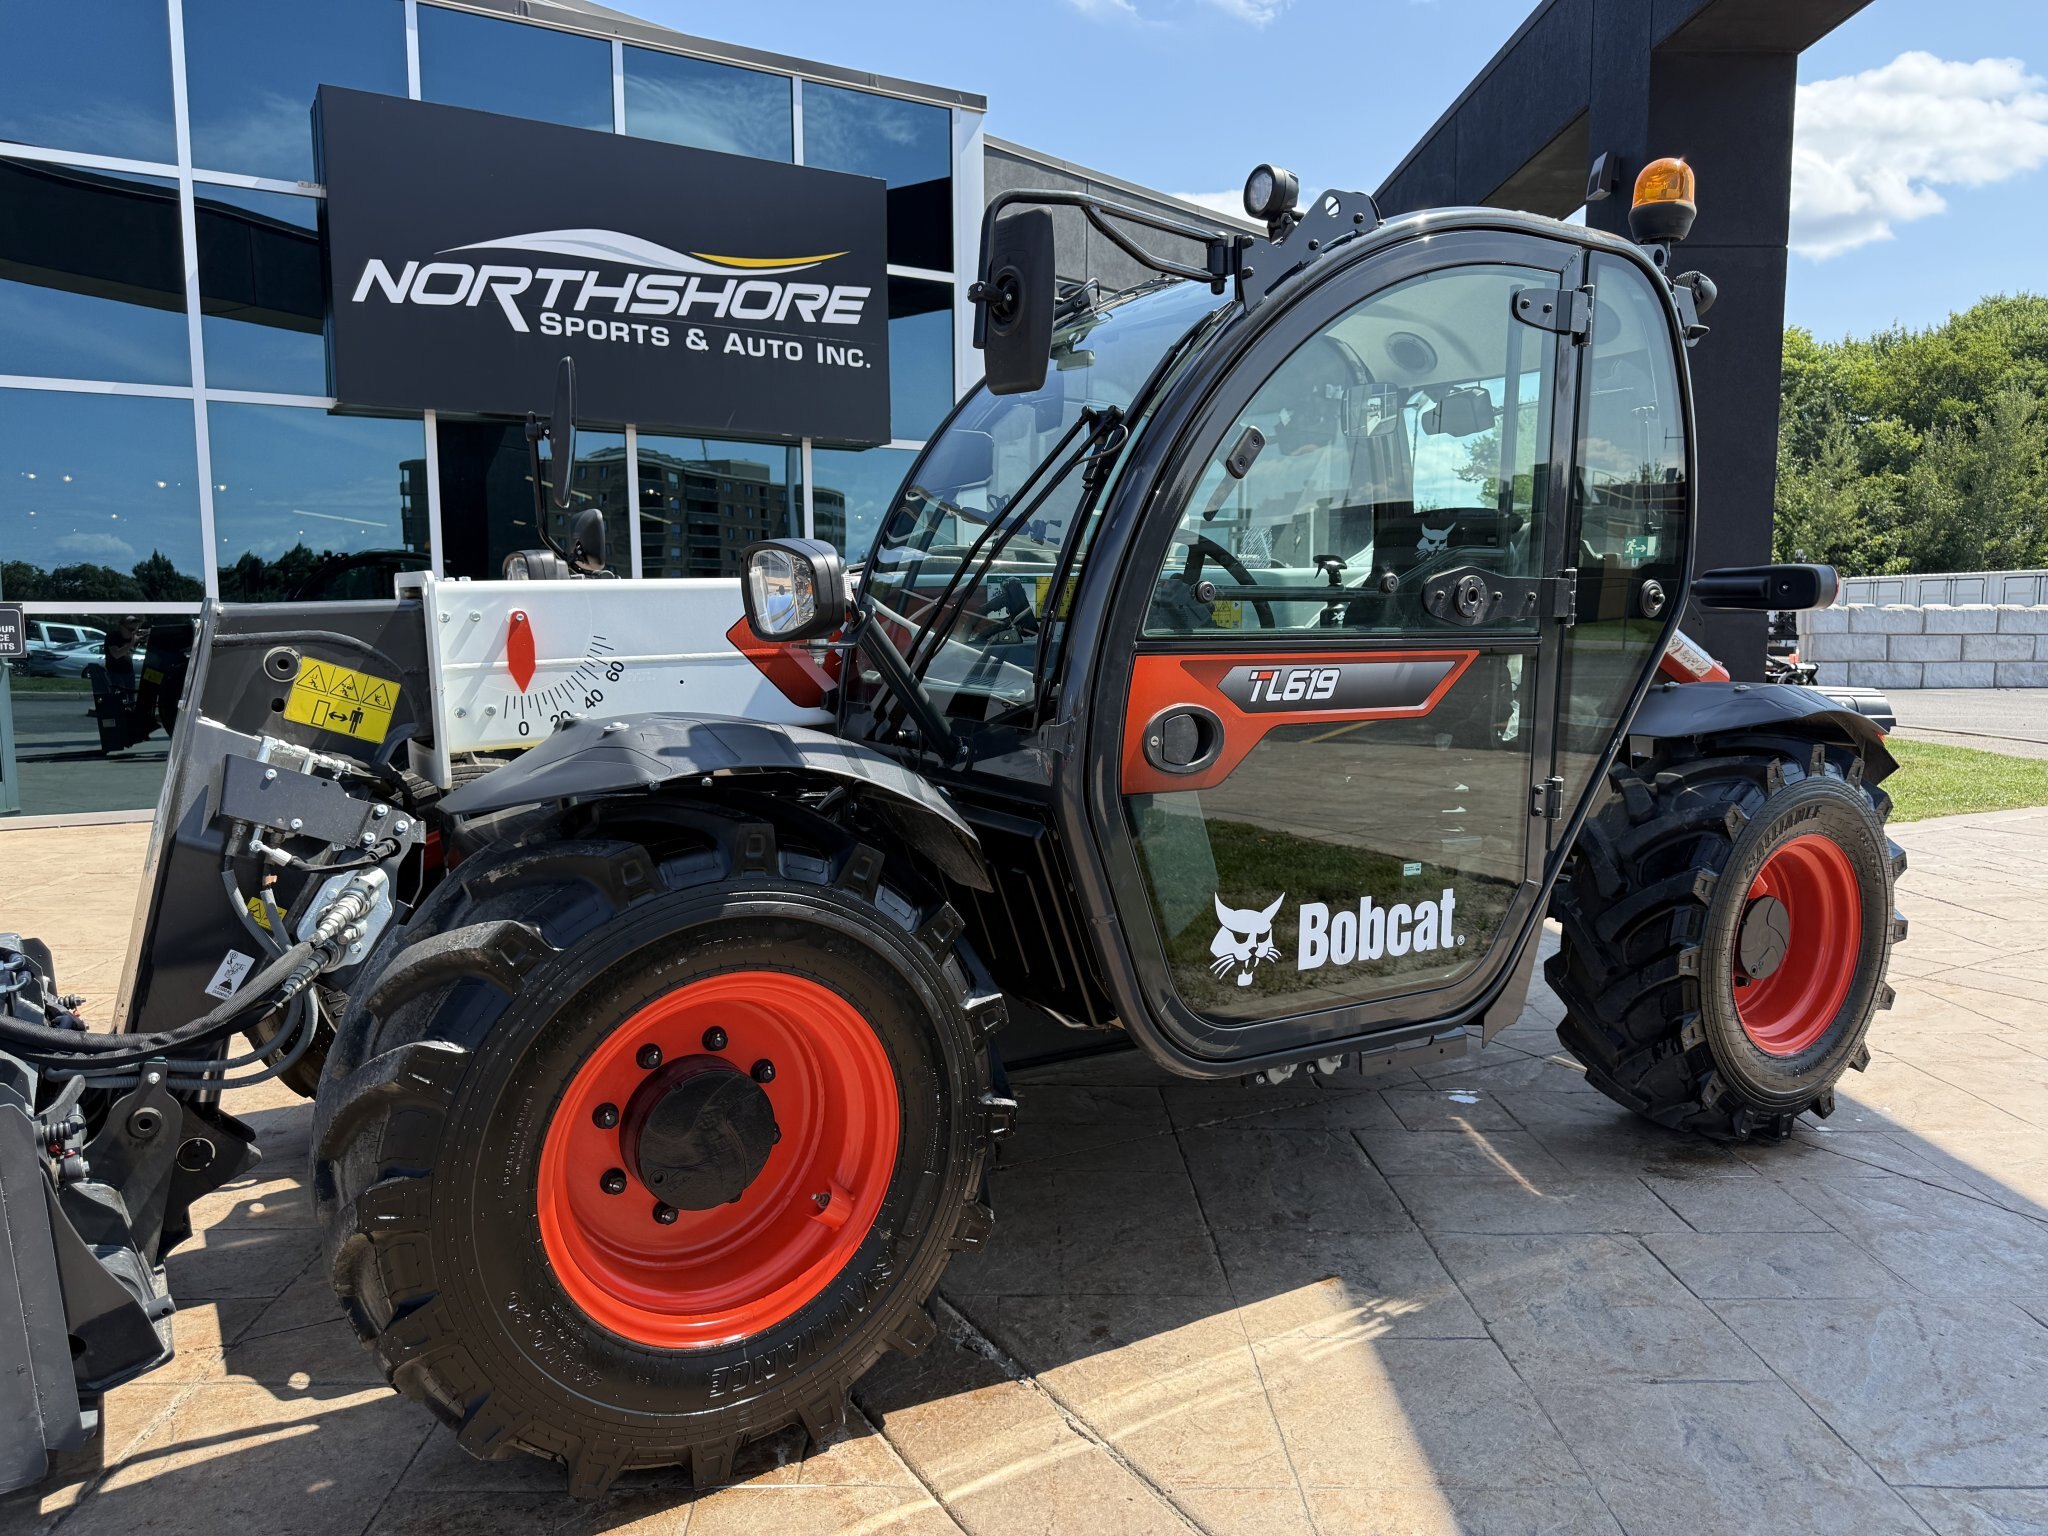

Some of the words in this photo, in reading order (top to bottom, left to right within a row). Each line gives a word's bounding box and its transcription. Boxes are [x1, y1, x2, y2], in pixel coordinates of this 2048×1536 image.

[352, 259, 871, 333] NORTHSHORE
[540, 312, 669, 348] SPORTS
[685, 328, 709, 351] &
[723, 332, 803, 361] AUTO
[817, 342, 871, 369] INC.
[605, 660, 625, 682] 60
[1250, 668, 1341, 702] TL619
[585, 688, 604, 710] 40
[518, 721, 530, 736] 0
[1298, 888, 1456, 971] Bobcat
